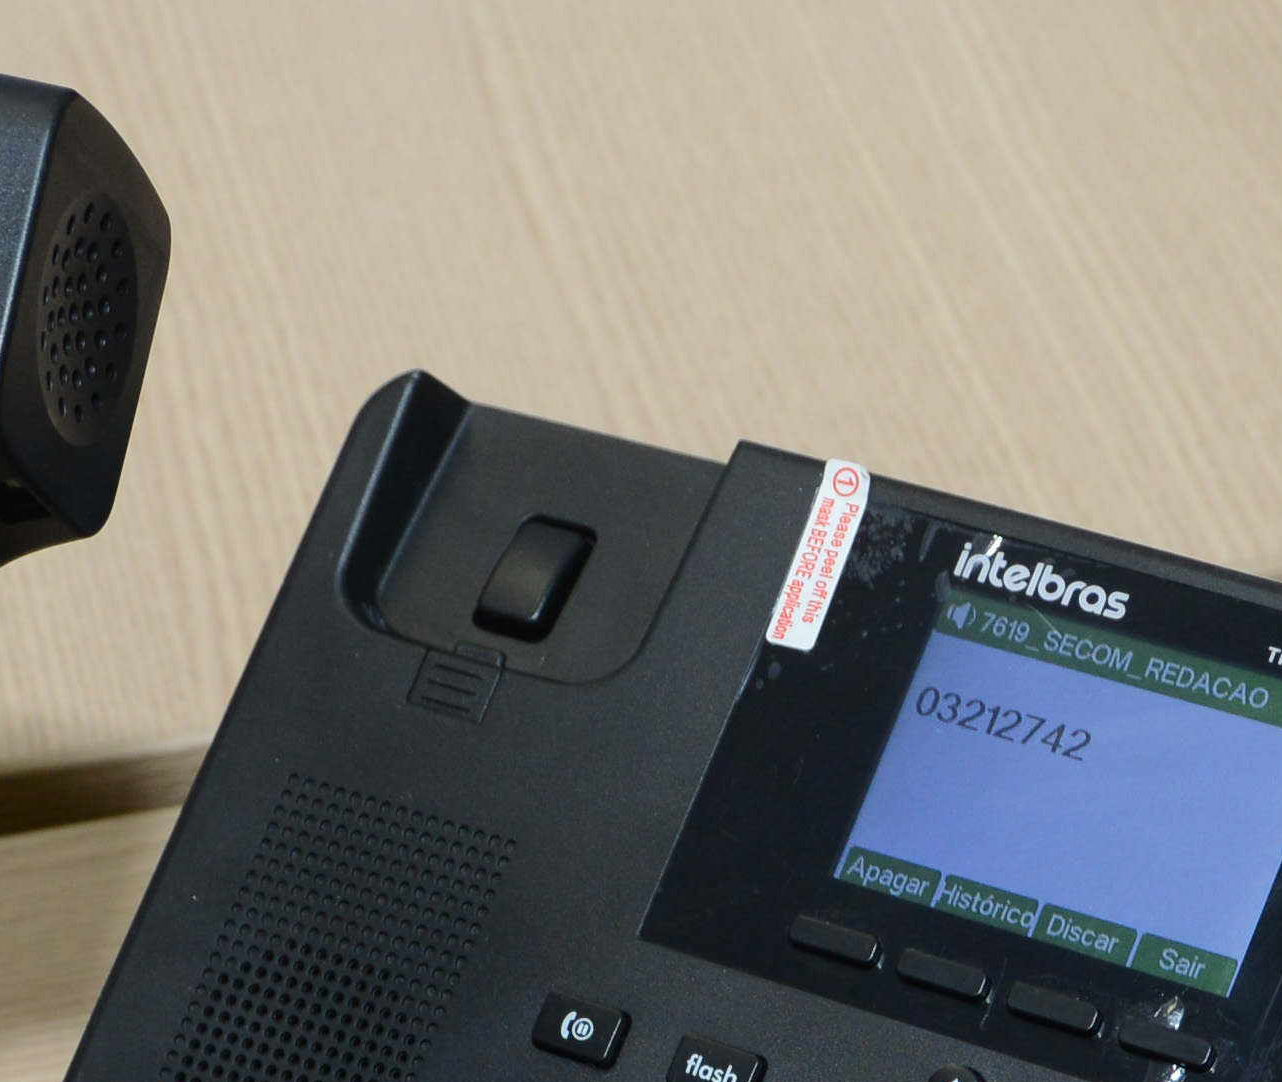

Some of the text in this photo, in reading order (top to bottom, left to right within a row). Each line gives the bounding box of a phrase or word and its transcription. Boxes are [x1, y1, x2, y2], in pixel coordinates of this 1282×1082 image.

[771, 497, 835, 640] mask BEFORE application
[802, 503, 860, 624] Please peel off this
[953, 542, 1130, 620] intelbras
[980, 611, 1269, 709] 7619_SECOM_REDACAO
[916, 686, 1092, 762] 03212742
[847, 856, 930, 897] Apagar
[939, 881, 1035, 929] Histórico
[1046, 913, 1120, 954] Discar
[1159, 947, 1207, 979] Sair
